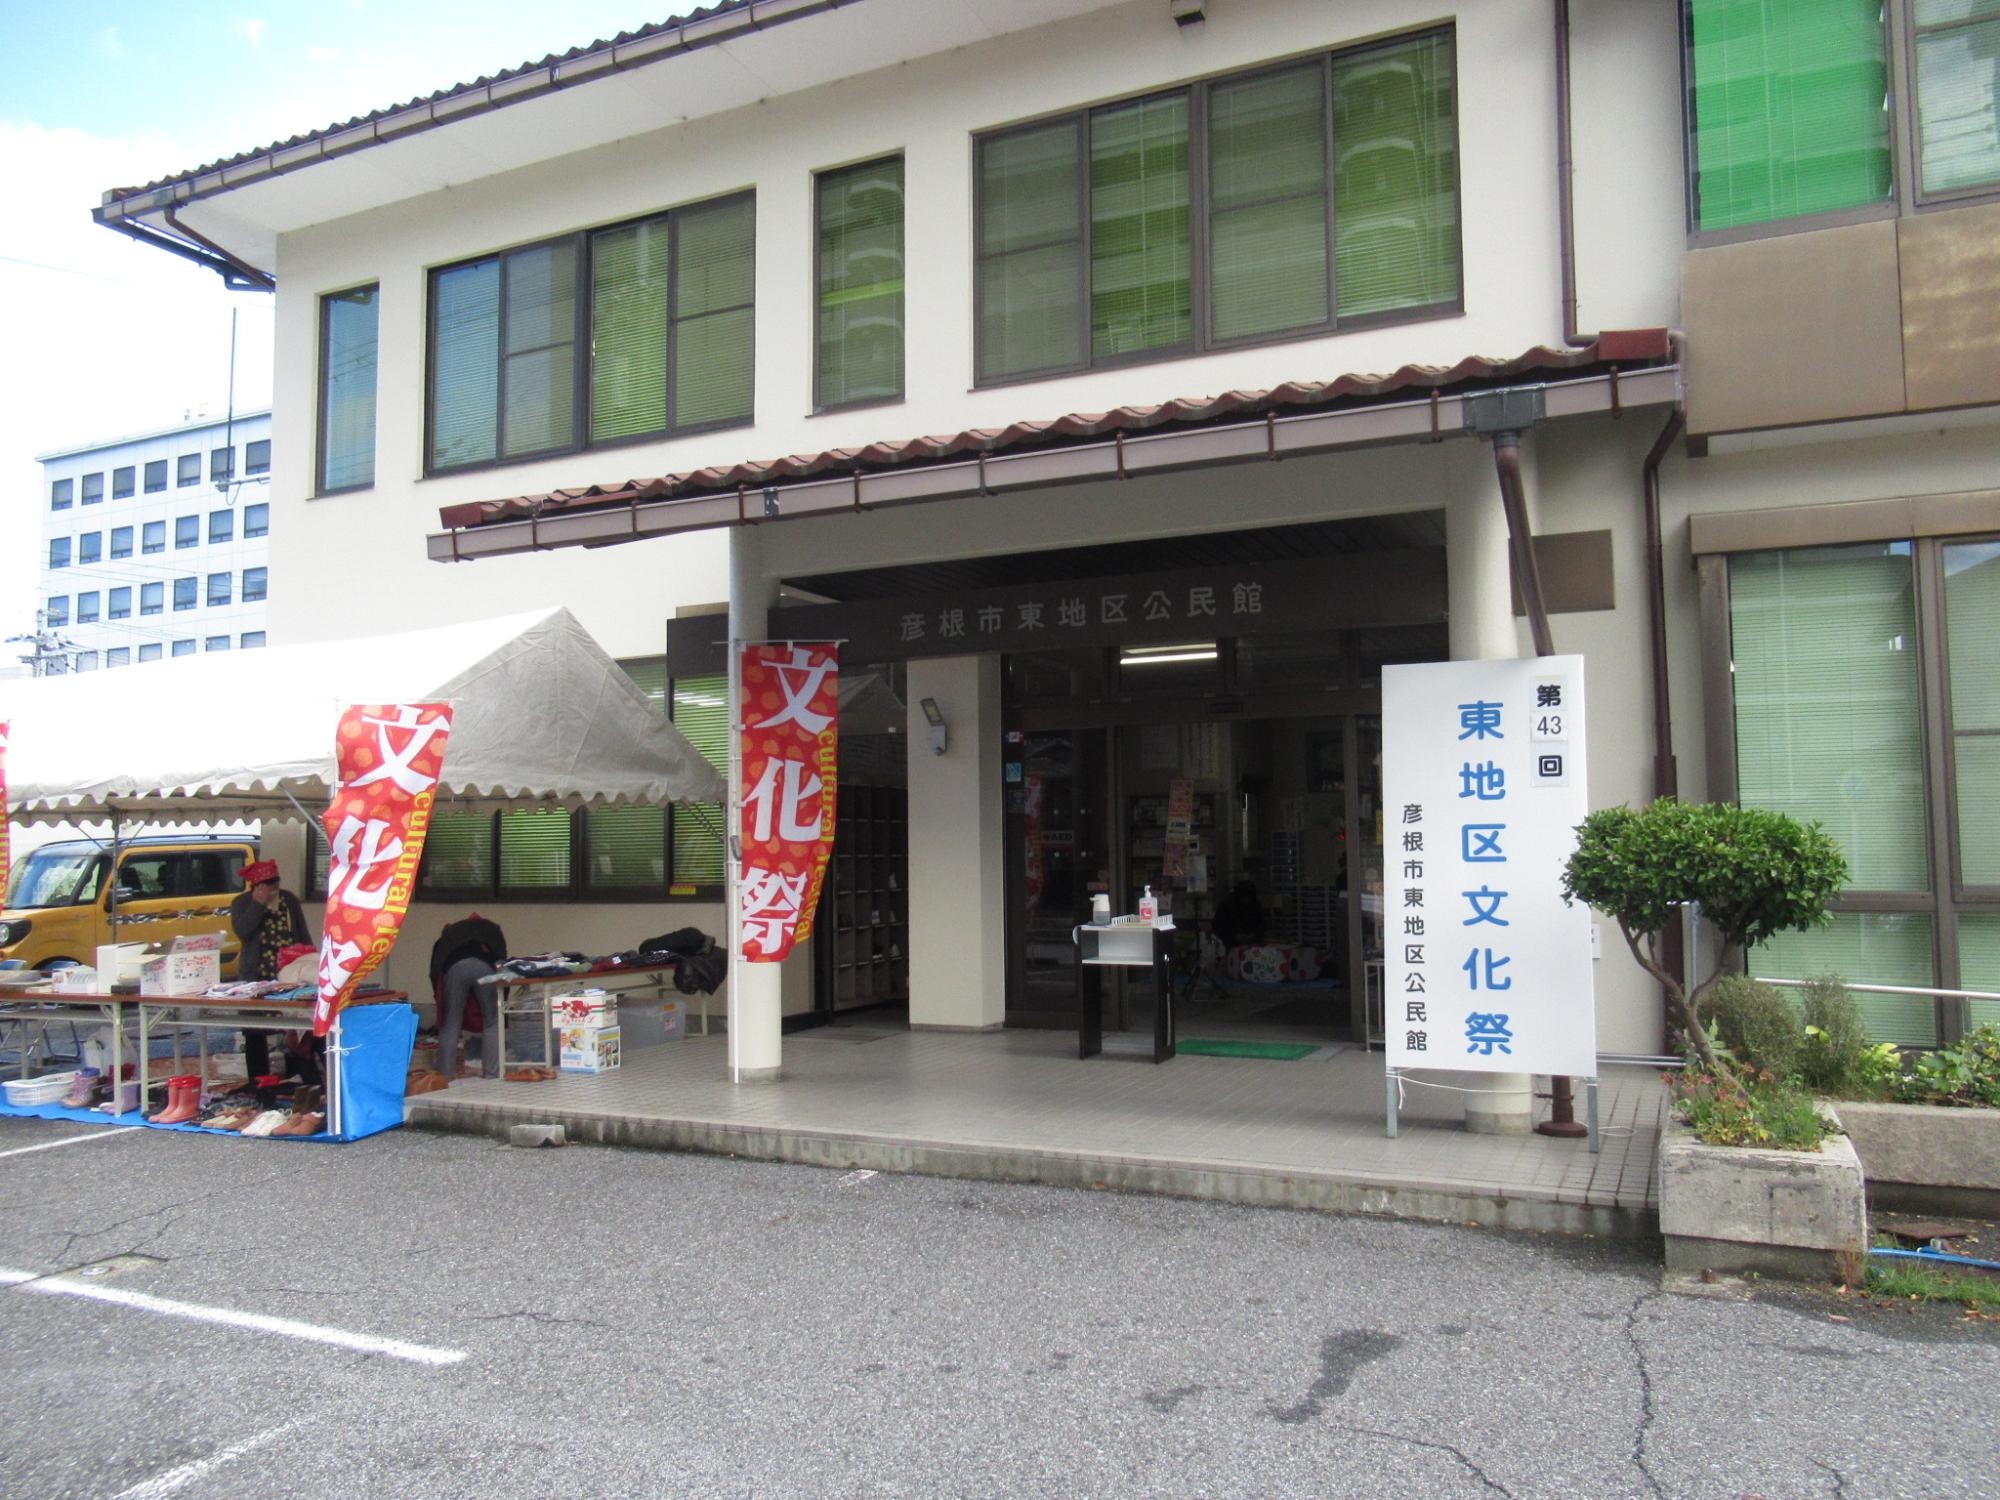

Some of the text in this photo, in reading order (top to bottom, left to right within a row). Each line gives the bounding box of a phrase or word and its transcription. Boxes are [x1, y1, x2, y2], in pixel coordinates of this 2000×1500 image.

[900, 582, 1262, 641] 彦根市東地区公民館
[817, 730, 835, 843] cultural
[1537, 684, 1563, 777] 第43回
[382, 792, 431, 914] cultural
[741, 648, 838, 954] 文化祭
[1402, 803, 1428, 1052] 彦根市東地区公民館
[1457, 700, 1513, 1055] 東地区文化祭
